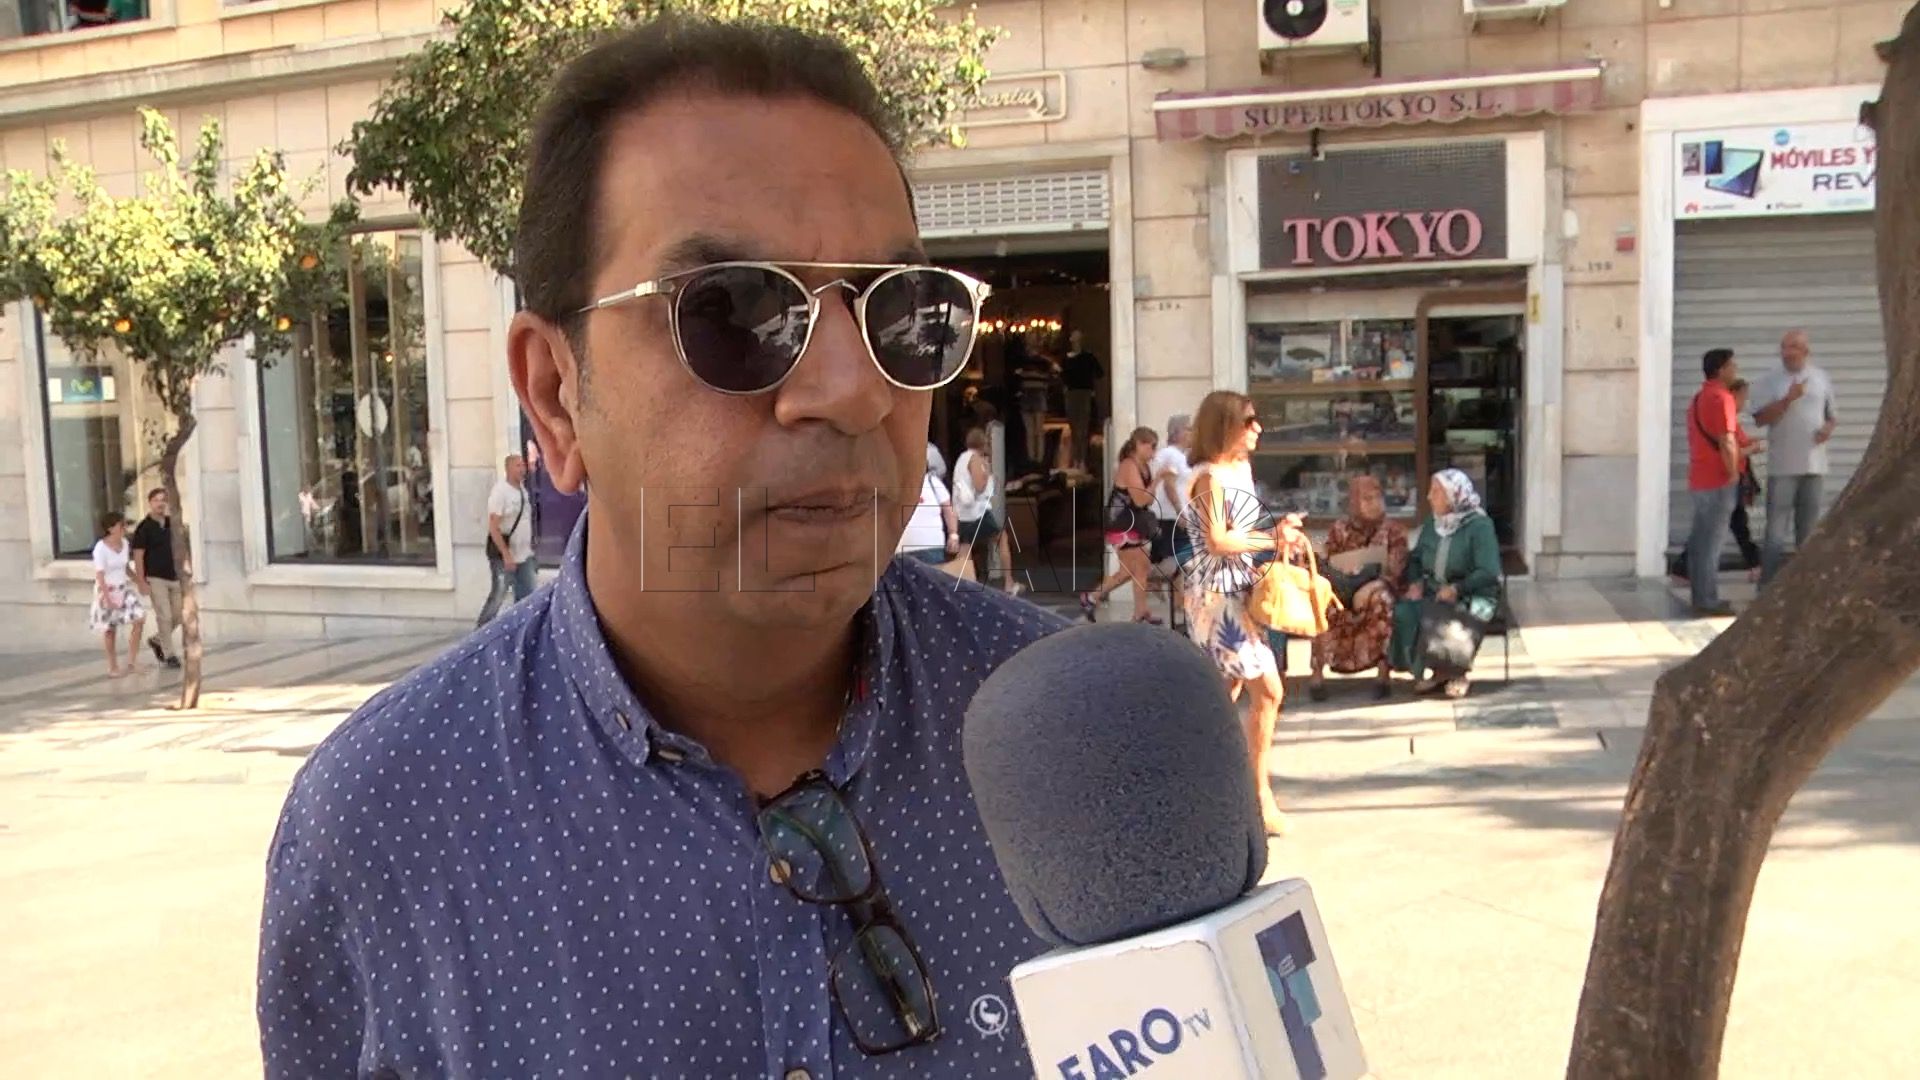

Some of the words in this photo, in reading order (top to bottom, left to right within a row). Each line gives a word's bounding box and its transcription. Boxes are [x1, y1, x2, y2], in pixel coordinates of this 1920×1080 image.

[1244, 94, 1436, 129] SUPERTOKYO
[1450, 92, 1502, 114] S.L.
[1770, 147, 1854, 170] MÓVILES
[1283, 209, 1482, 265] TOKYO
[1056, 1008, 1182, 1080] FARO
[1183, 1008, 1212, 1038] TV
